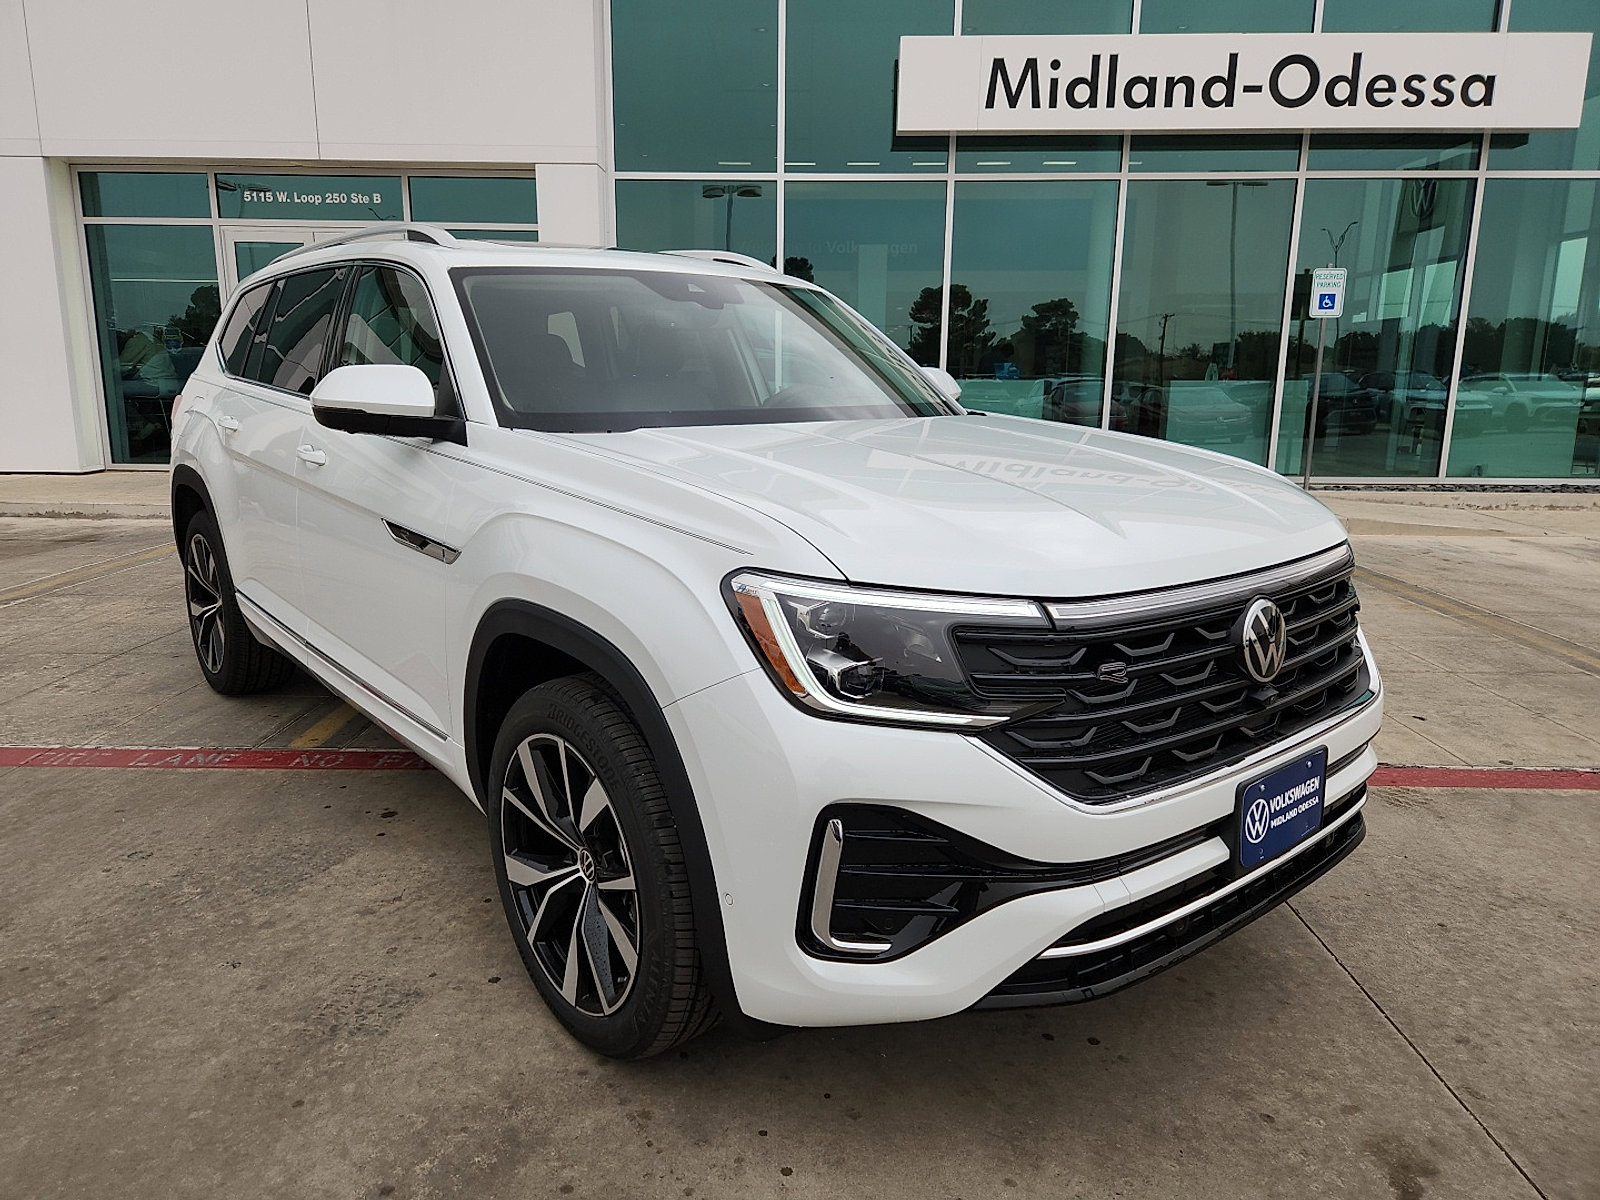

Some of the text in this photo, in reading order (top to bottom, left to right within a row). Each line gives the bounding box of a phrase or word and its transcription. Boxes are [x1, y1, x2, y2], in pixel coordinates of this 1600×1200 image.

[984, 52, 1497, 109] Midland-Odessa
[243, 191, 382, 205] 5115 W. Loop 250 Ste B
[1315, 272, 1345, 280] RESERVED
[128, 752, 241, 766] LANE
[288, 753, 345, 767] NO
[547, 702, 622, 793] BRIDGESTONE
[1269, 775, 1320, 814] VOLKSWAGEN
[1270, 795, 1319, 829] MIDLAND ODESSA
